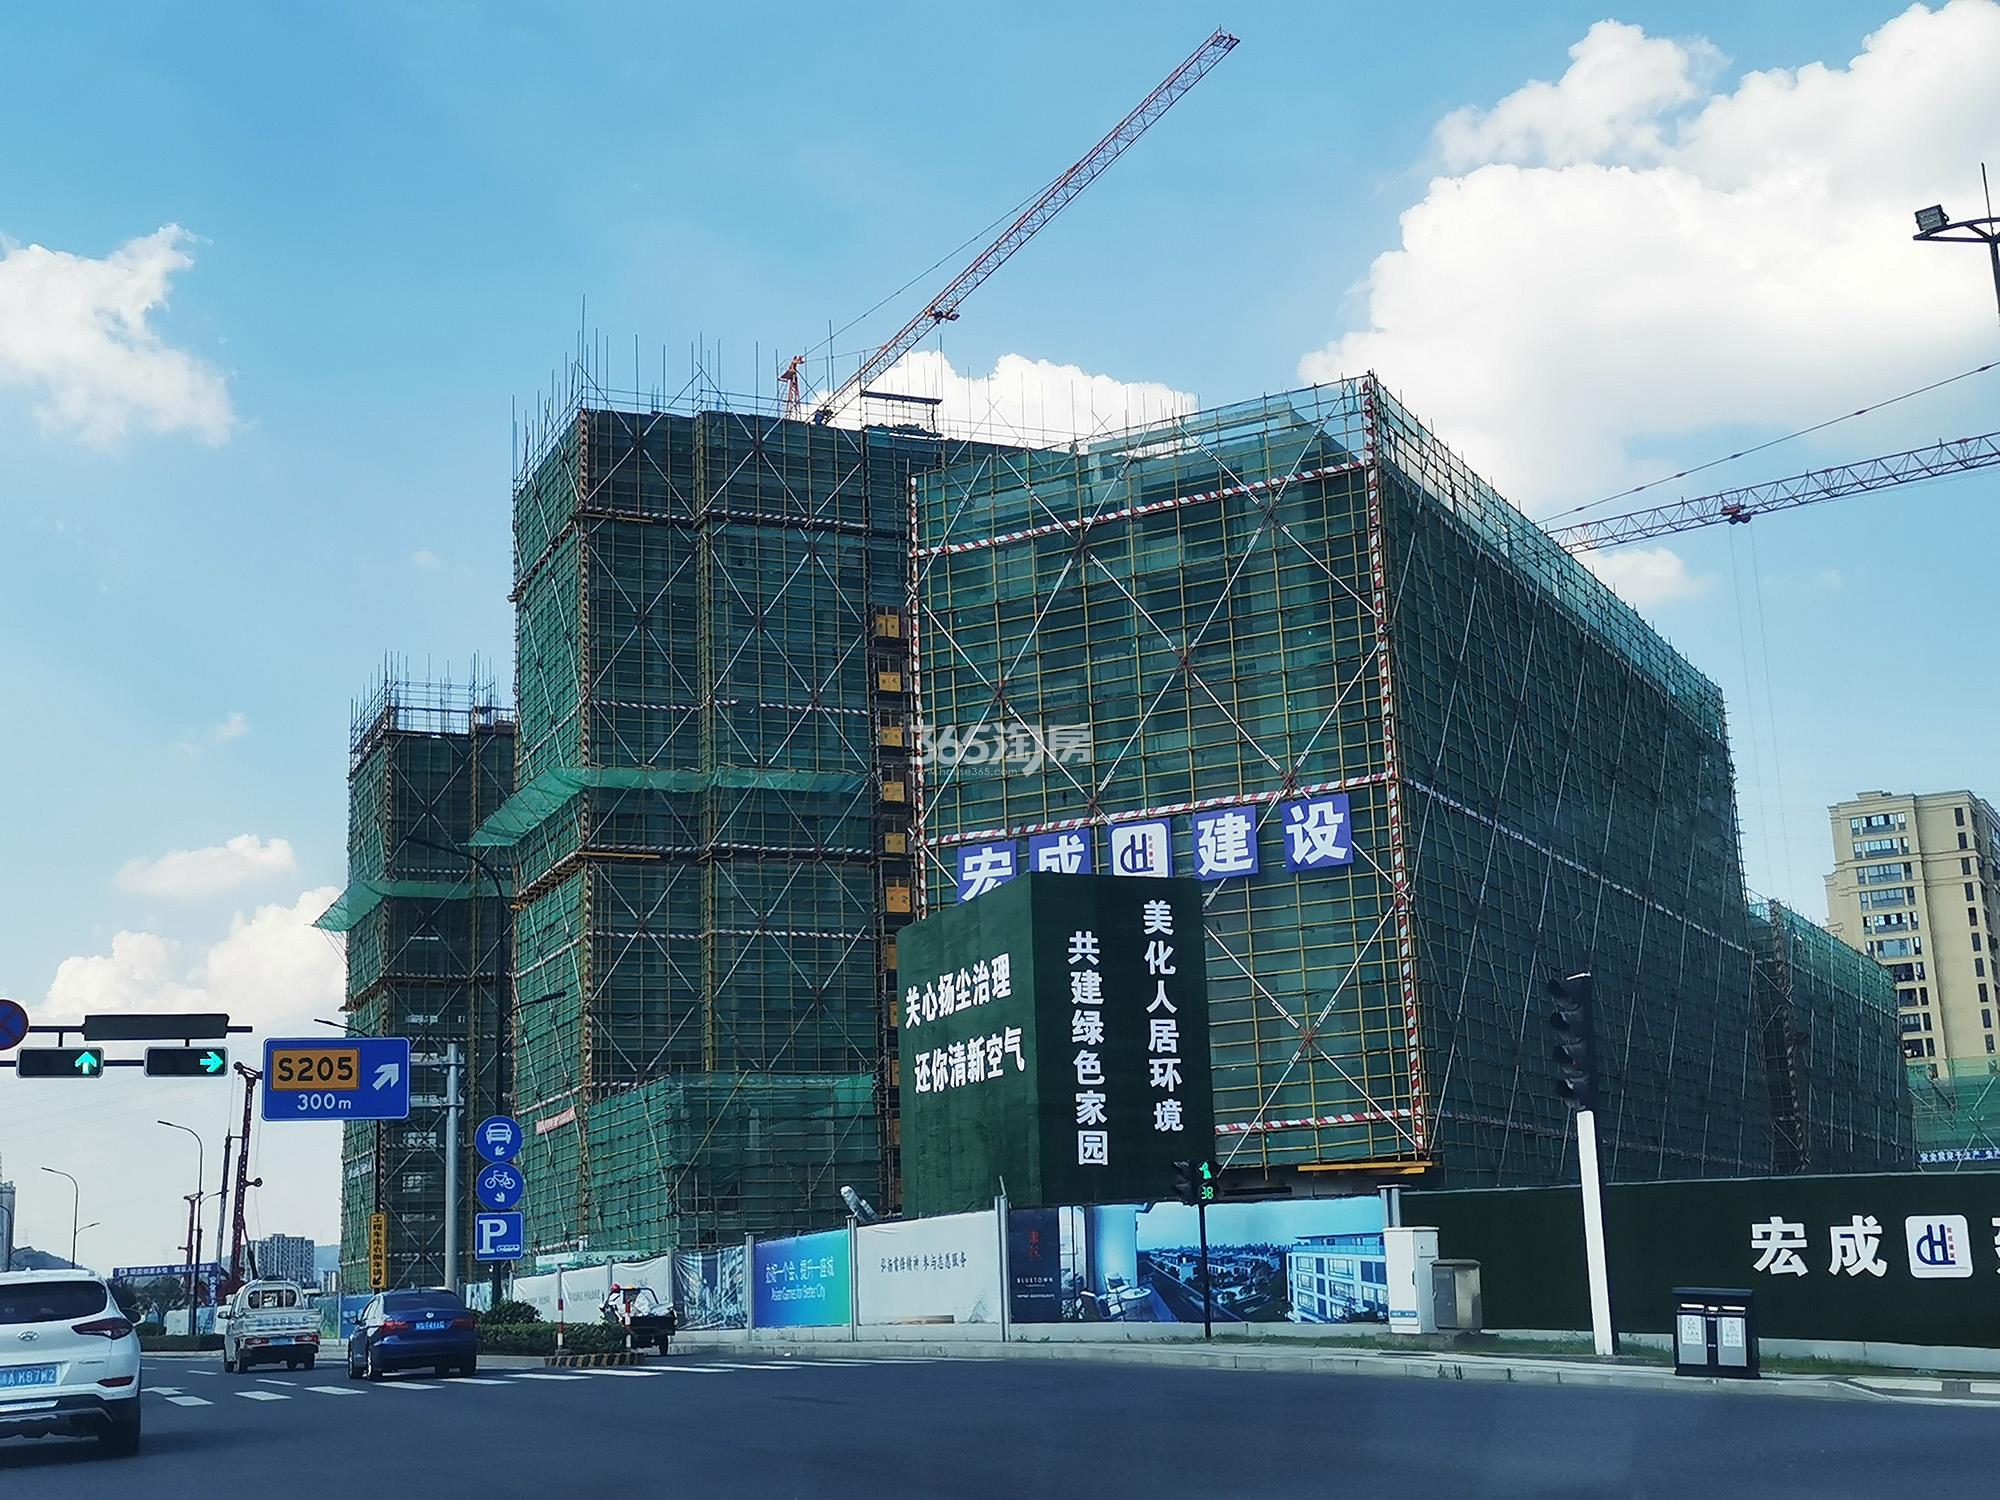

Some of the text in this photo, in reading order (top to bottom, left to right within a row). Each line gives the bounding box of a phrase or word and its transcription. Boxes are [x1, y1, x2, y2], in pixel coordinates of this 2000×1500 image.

[905, 952, 1012, 1029] 关心扬尘治理
[1143, 900, 1184, 1132] 美化人居环境
[278, 1056, 353, 1081] S205
[914, 1026, 1025, 1093] 还你清新空气
[1067, 931, 1109, 1165] 共建绿色家园
[479, 1219, 507, 1254] P
[1751, 1214, 1889, 1277] 宏成
